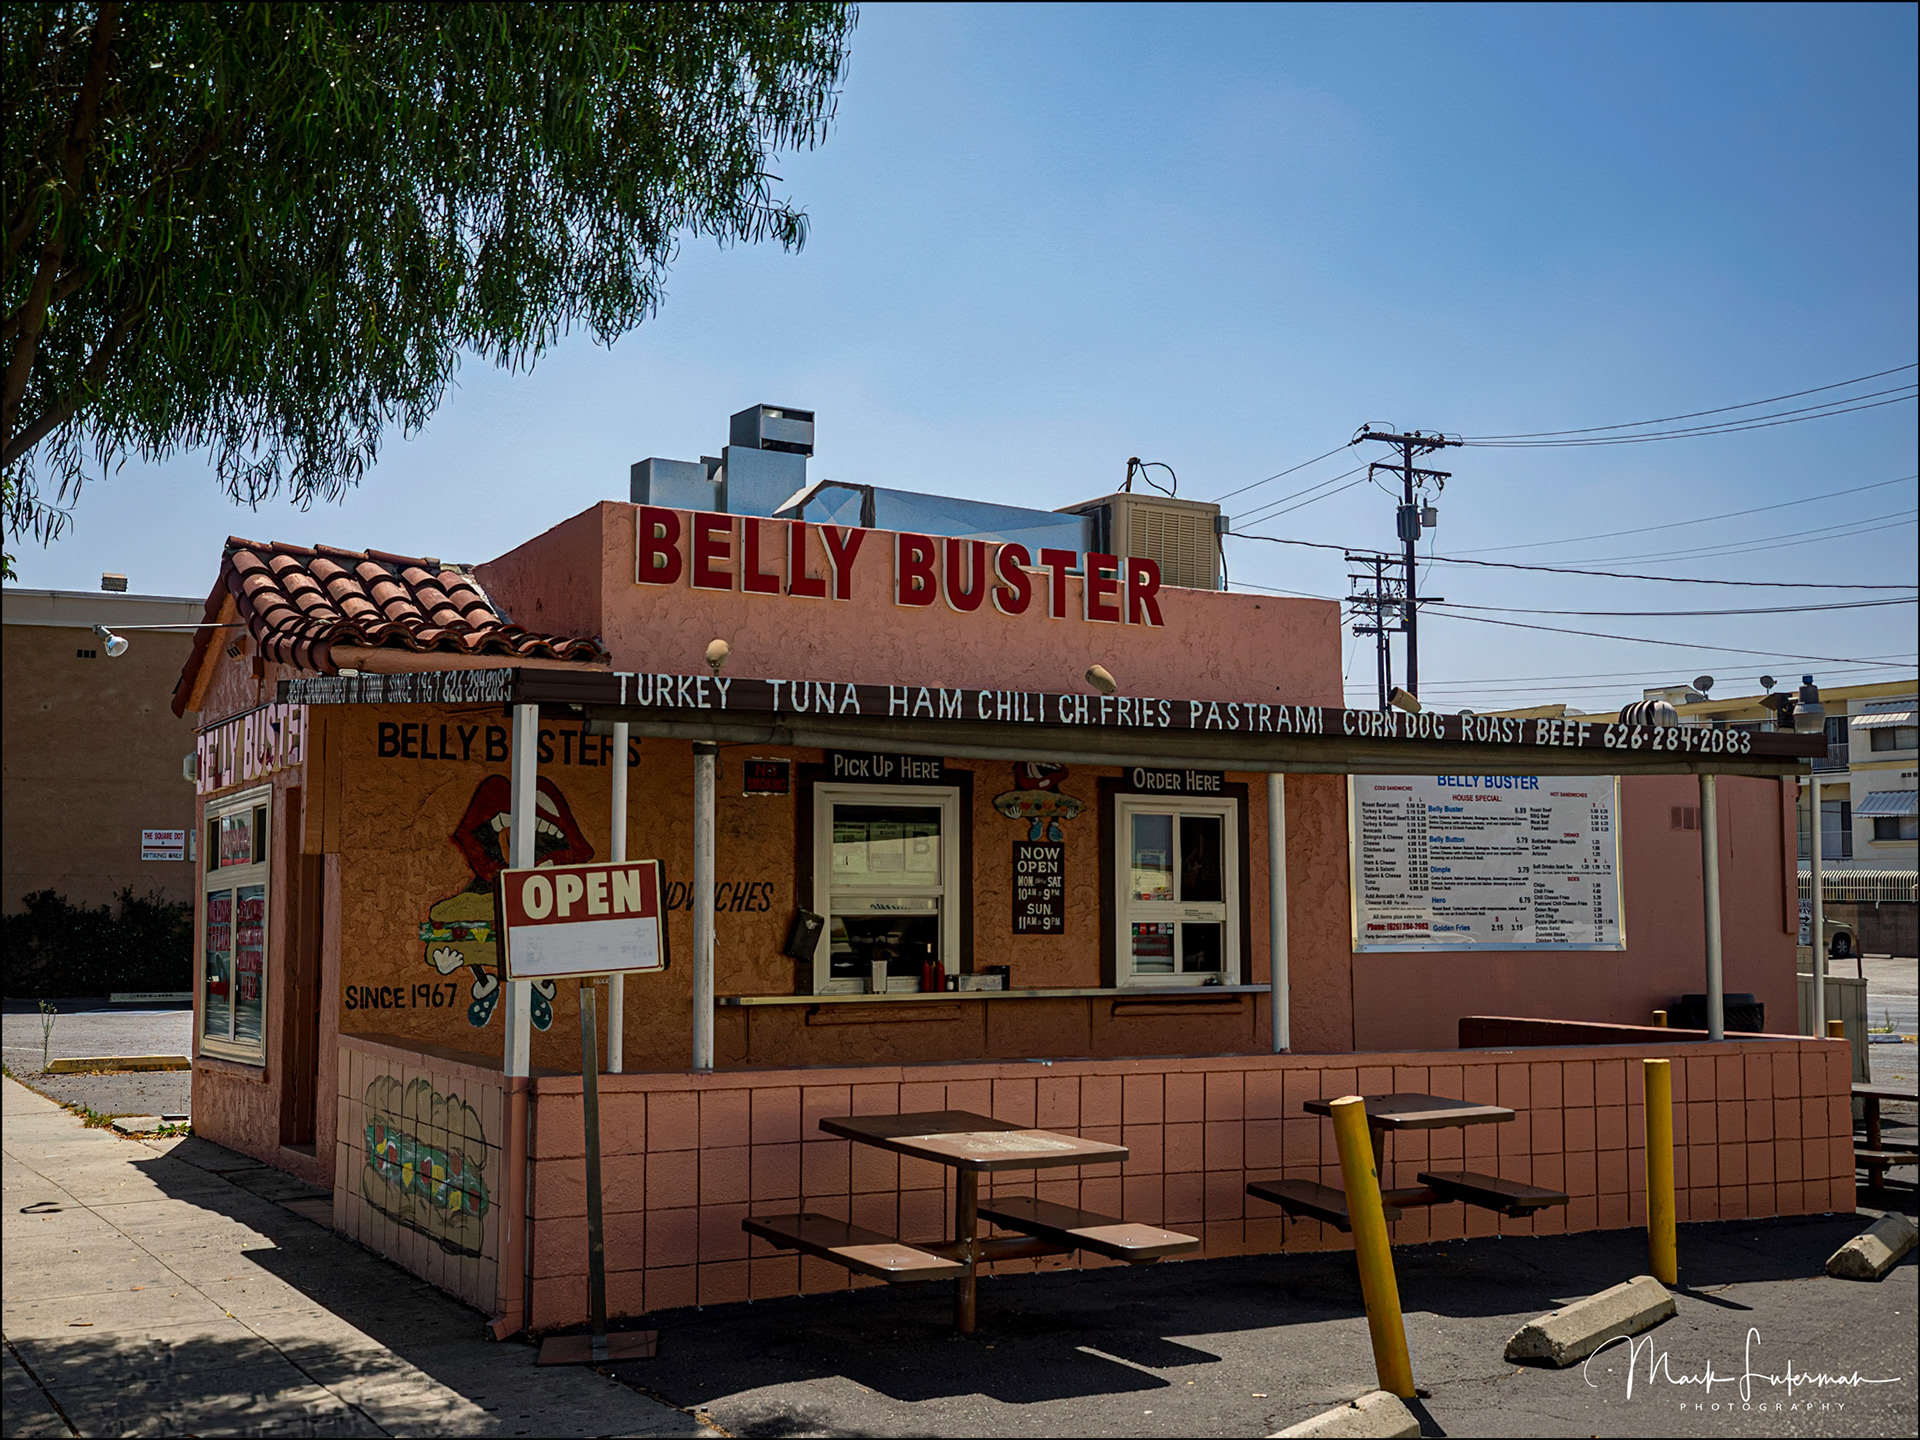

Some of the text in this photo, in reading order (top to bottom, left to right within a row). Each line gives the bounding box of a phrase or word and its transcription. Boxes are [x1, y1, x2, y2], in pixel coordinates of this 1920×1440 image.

[636, 506, 1164, 627] BELLY BUSTER
[613, 672, 732, 710] TURKEY
[766, 678, 860, 715] TUNA
[888, 686, 963, 720] HAM
[978, 690, 1046, 724] CHILI
[1190, 700, 1324, 735] PASTRAMI
[1343, 710, 1398, 738] CORN
[1405, 712, 1445, 740] DOG
[1460, 716, 1527, 743] ROAST
[1534, 718, 1592, 747] BEEF
[196, 702, 304, 795] BELLY BUSTE
[378, 722, 642, 768] BELLY BSTERS
[900, 756, 940, 780] HERE
[1186, 770, 1220, 792] HERE
[1437, 775, 1539, 790] BELLY BUSTER
[1428, 806, 1443, 814] Belly
[1429, 836, 1444, 844] Belly
[1020, 846, 1060, 860] NOW
[1017, 860, 1058, 873] OPEN
[1430, 866, 1451, 874] Dimple
[521, 868, 642, 920] OPEN
[345, 983, 458, 1010] SINCE 1967
